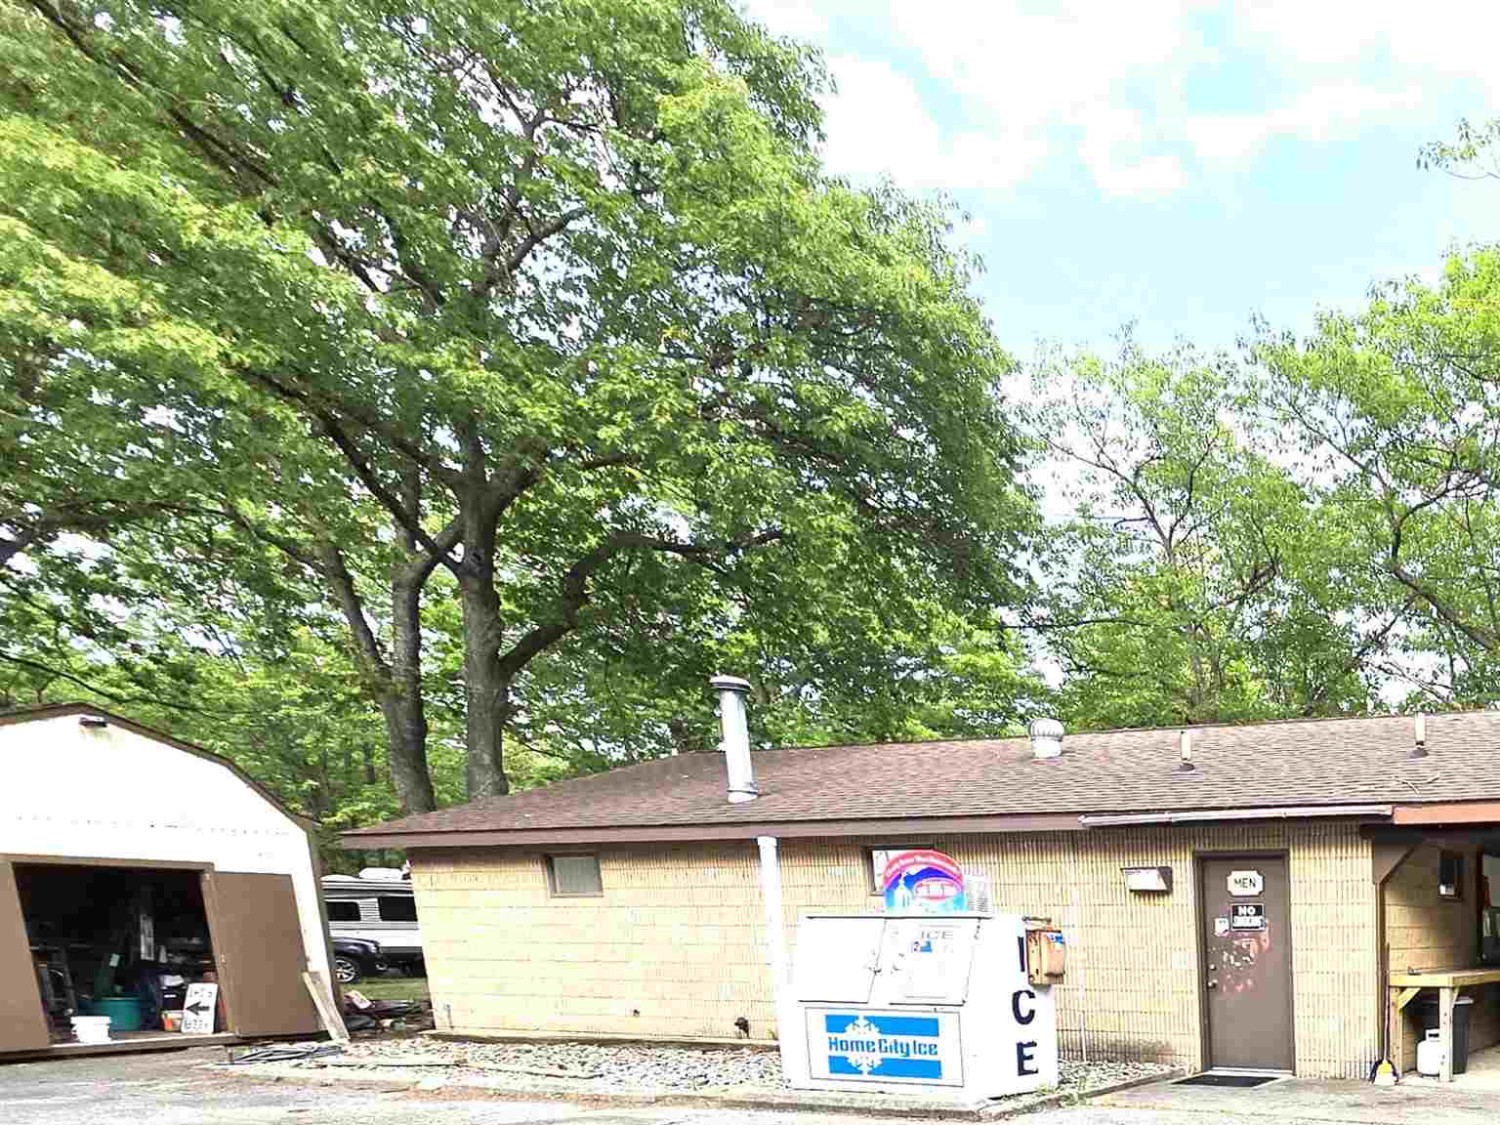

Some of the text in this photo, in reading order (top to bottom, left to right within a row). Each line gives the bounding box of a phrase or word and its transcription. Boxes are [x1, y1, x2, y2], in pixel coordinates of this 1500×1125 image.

[1233, 877, 1257, 889] MEN
[1238, 905, 1256, 916] NO
[1011, 936, 1039, 1077] ICE
[827, 1036, 939, 1058] Home City Ice
